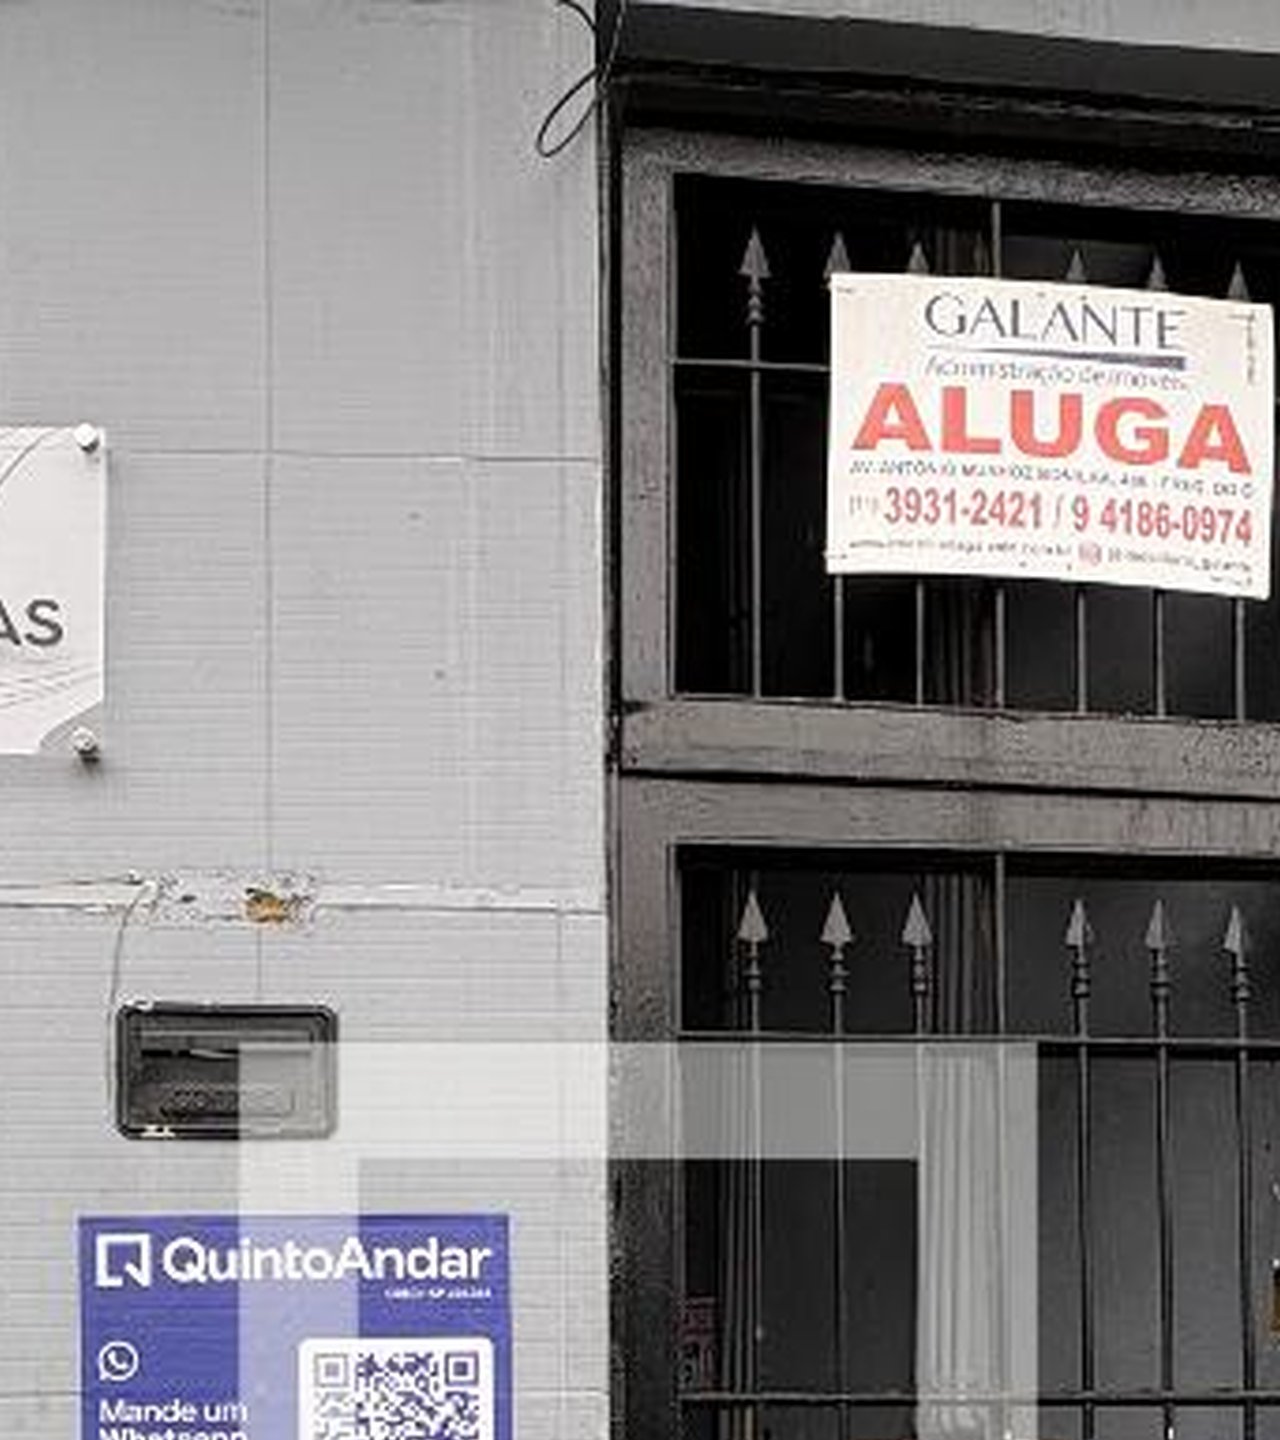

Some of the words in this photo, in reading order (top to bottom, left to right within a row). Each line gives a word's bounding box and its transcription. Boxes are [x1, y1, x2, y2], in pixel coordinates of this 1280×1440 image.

[925, 294, 1186, 350] GALANTE
[851, 382, 1253, 475] ALUGA
[884, 486, 1042, 529] 3931-2421
[1072, 495, 1090, 532] 9
[1099, 498, 1253, 547] 4186-0974
[162, 1236, 493, 1284] QuintoAndar
[99, 1400, 197, 1423] Mande
[204, 1402, 248, 1423] um
